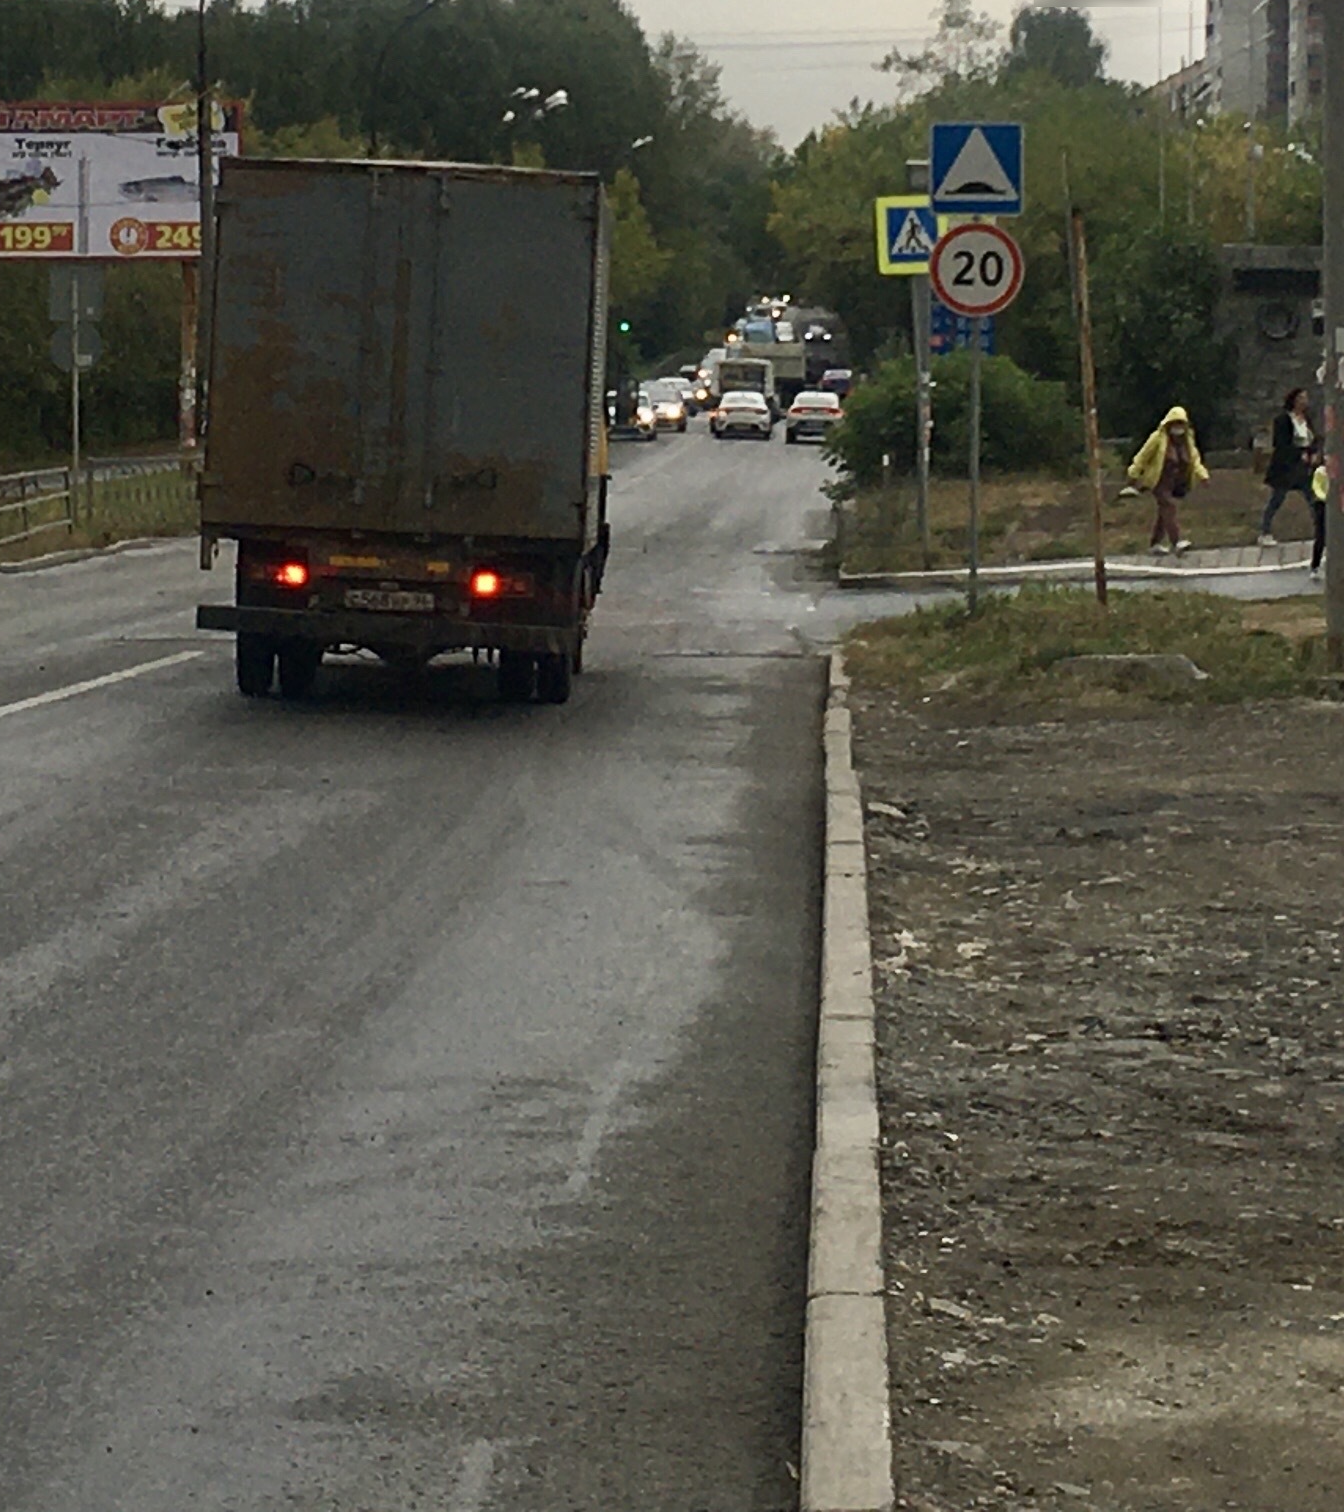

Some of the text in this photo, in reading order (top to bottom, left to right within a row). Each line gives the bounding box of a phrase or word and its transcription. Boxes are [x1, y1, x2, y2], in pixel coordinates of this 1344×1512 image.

[14, 137, 72, 153] Терпуг
[0, 225, 52, 250] 199
[155, 225, 202, 250] 249
[952, 251, 1004, 287] 20
